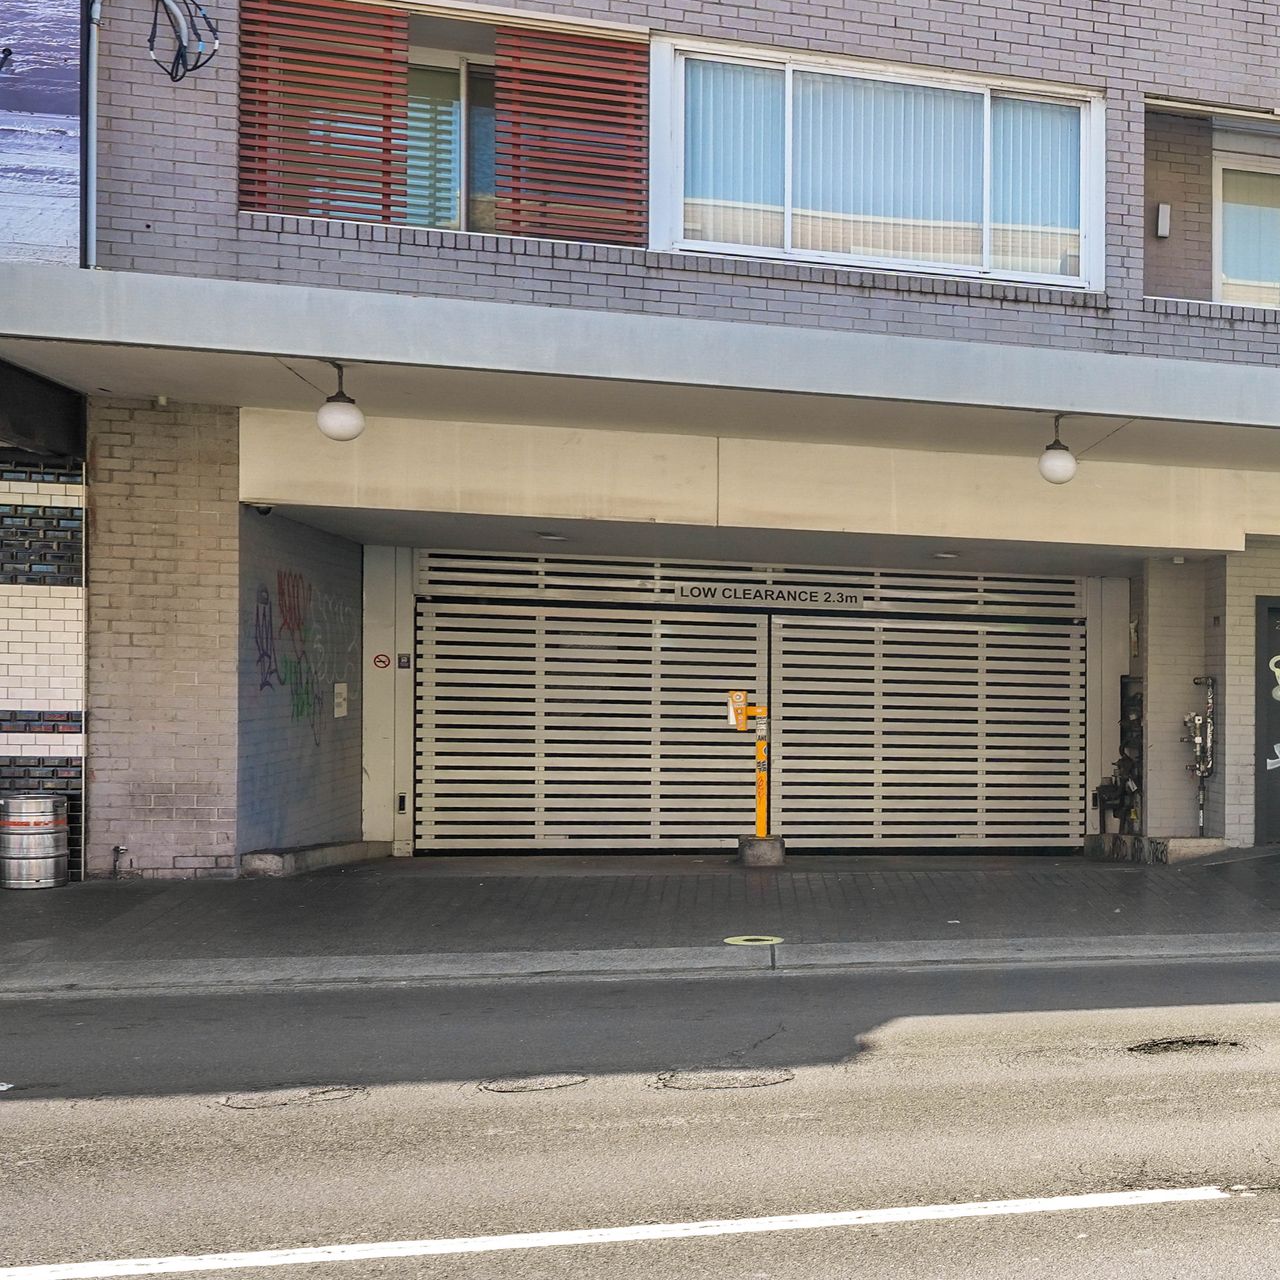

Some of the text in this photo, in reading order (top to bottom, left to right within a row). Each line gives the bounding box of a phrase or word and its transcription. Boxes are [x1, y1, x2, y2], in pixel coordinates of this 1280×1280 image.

[680, 586, 858, 603] LOW CLEARANCE 2.3m
